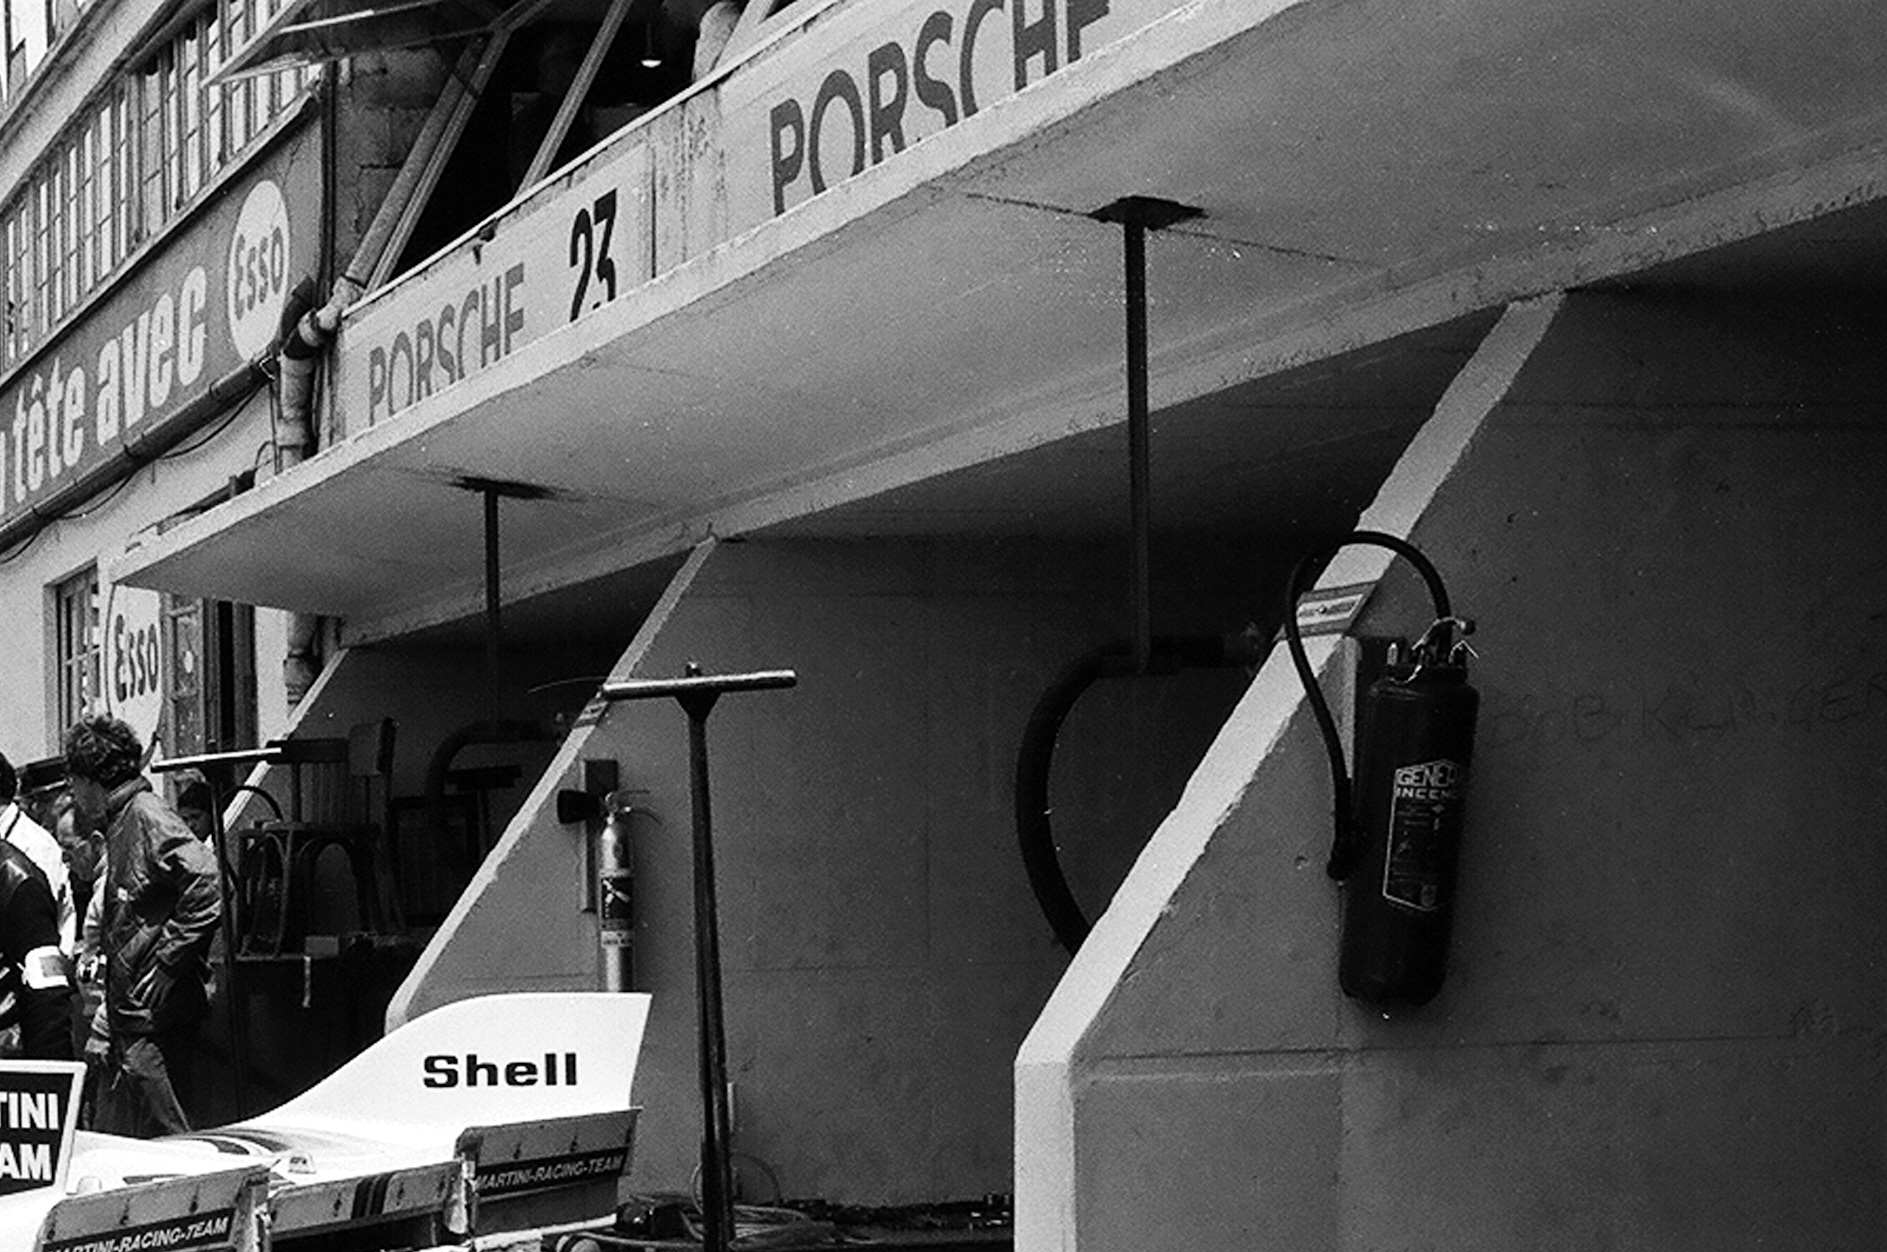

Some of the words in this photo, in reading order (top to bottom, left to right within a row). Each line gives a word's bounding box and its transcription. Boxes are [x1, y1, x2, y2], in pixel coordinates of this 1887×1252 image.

[12, 356, 86, 503] tête
[96, 265, 208, 447] avec
[233, 226, 284, 321] Esso
[369, 262, 524, 427] PORSCHE
[570, 188, 617, 323] 23
[116, 614, 158, 703] Esso
[423, 1053, 577, 1088] Shell
